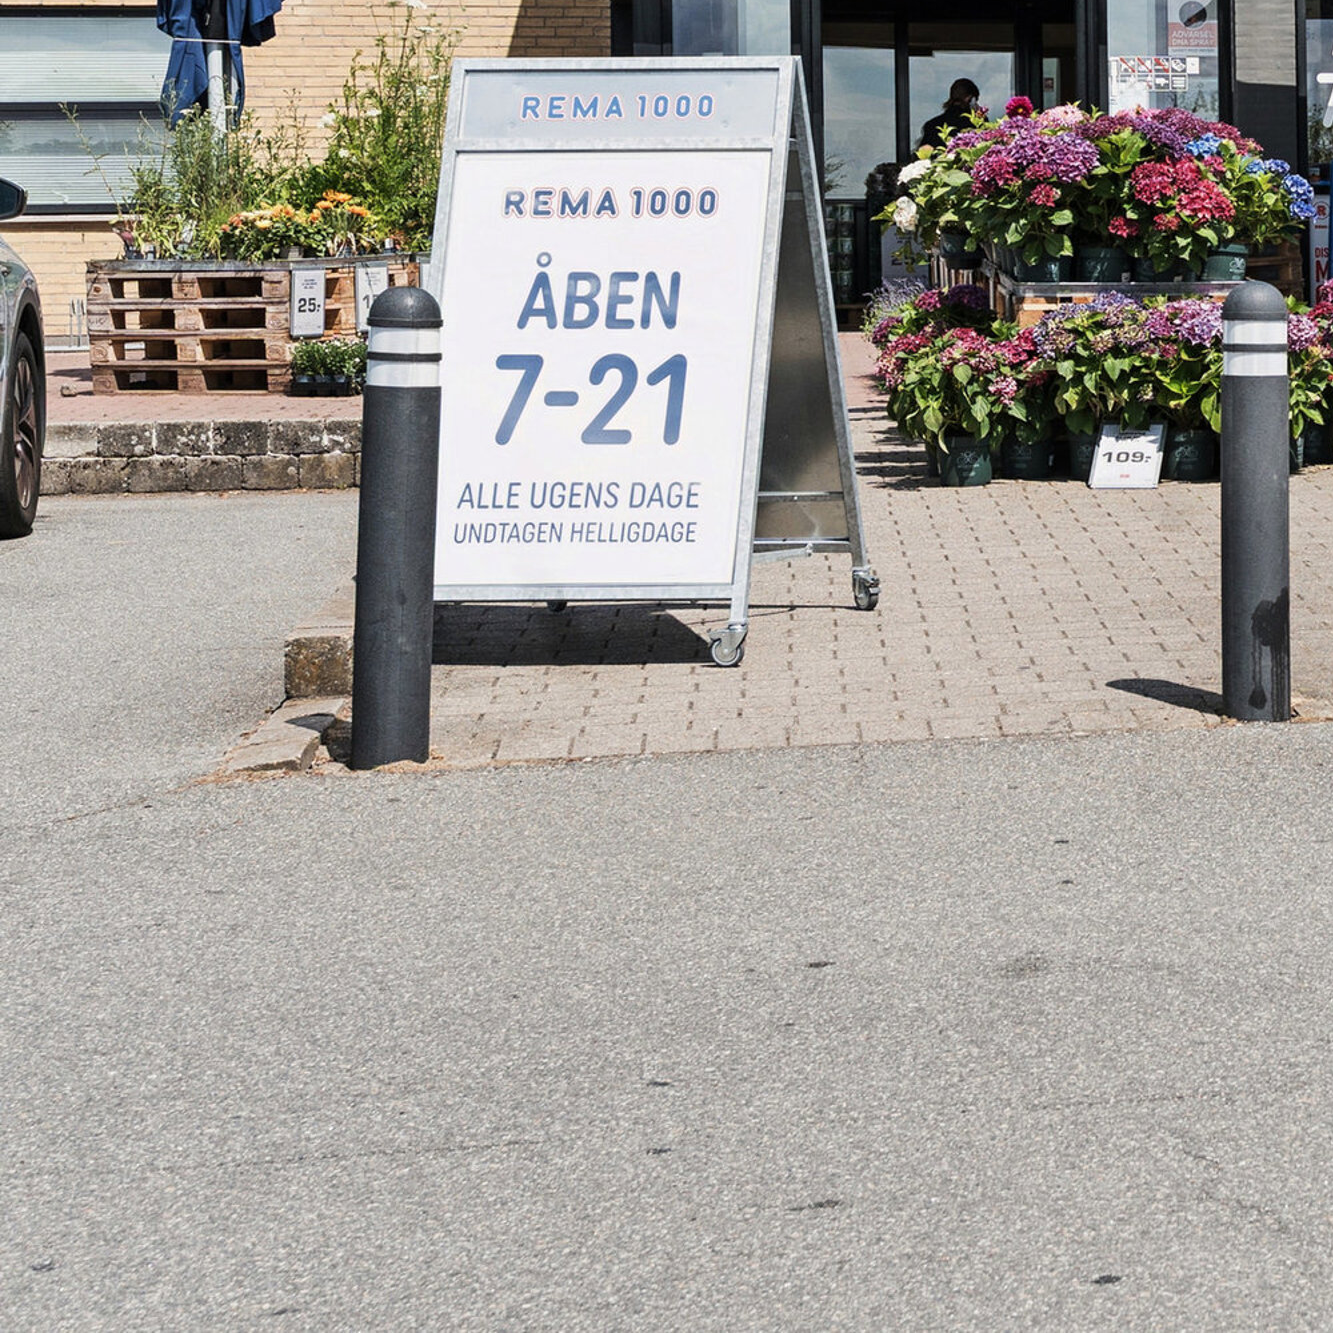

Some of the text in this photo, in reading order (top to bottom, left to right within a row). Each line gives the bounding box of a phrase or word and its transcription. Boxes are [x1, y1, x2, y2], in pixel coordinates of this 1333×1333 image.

[520, 93, 715, 120] REMA 1000
[503, 188, 718, 217] REMA 1000
[516, 252, 681, 330] ÅBEN
[495, 352, 688, 445] 7-21
[457, 481, 701, 509] ALLE UGENS DAGE
[454, 522, 697, 544] UNDTAGEN HELLIGDAGE
